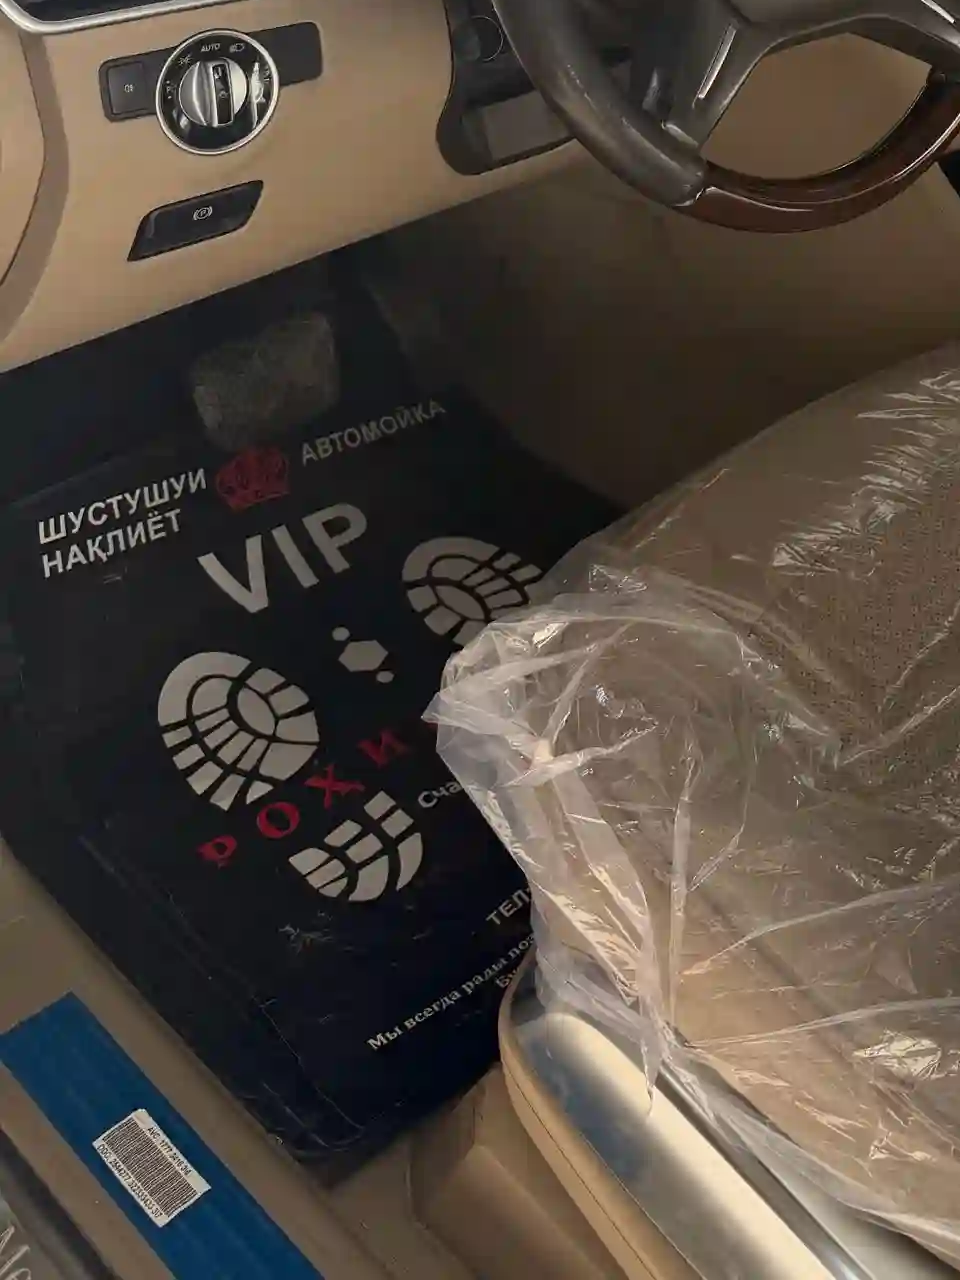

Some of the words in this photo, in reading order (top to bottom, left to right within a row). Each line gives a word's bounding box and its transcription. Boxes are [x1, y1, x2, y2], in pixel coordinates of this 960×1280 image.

[201, 42, 221, 53] AUTO
[301, 398, 447, 466] АВТОМОЙКА
[37, 467, 208, 545] ШУСТУШУИ
[197, 503, 368, 614] VIP
[366, 1026, 403, 1051] Мы
[403, 989, 462, 1031] всегда
[461, 956, 508, 995] рады
